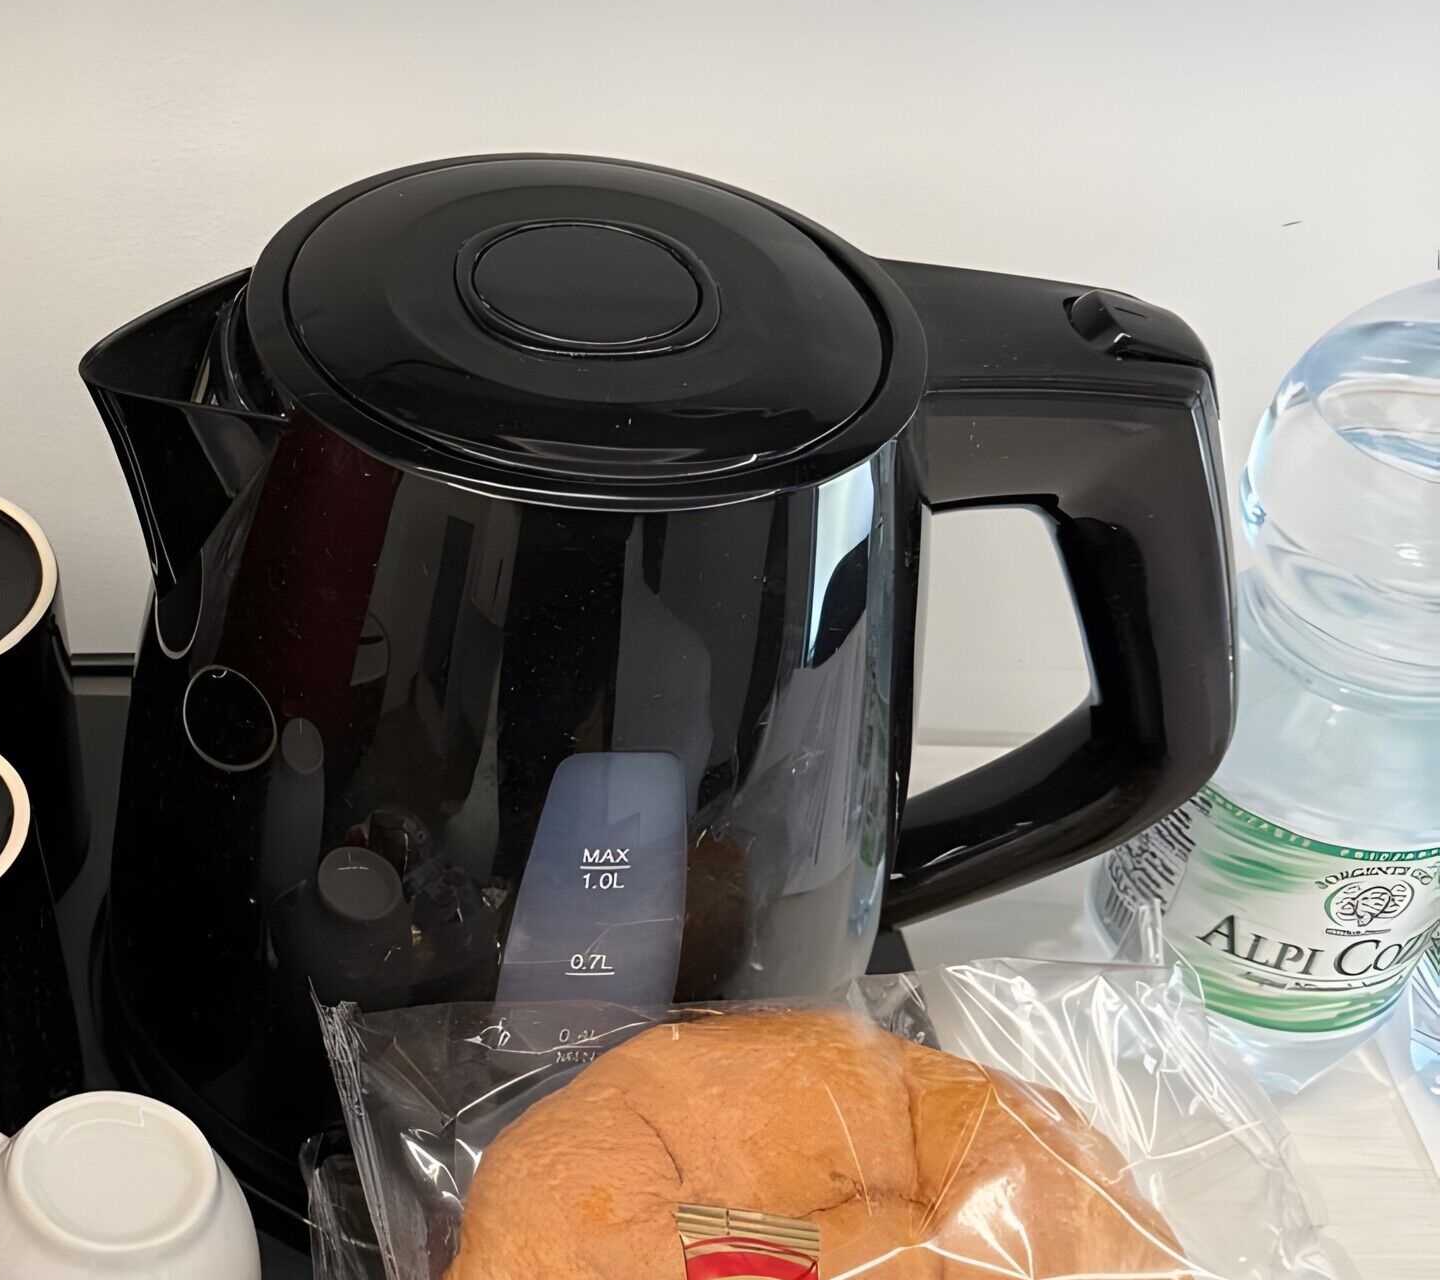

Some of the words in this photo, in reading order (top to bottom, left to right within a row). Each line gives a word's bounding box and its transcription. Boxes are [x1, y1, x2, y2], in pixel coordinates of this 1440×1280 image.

[582, 847, 631, 864] MAX
[583, 873, 625, 890] 1.0L
[1196, 914, 1326, 976] ALPI
[569, 953, 614, 971] 0.7L
